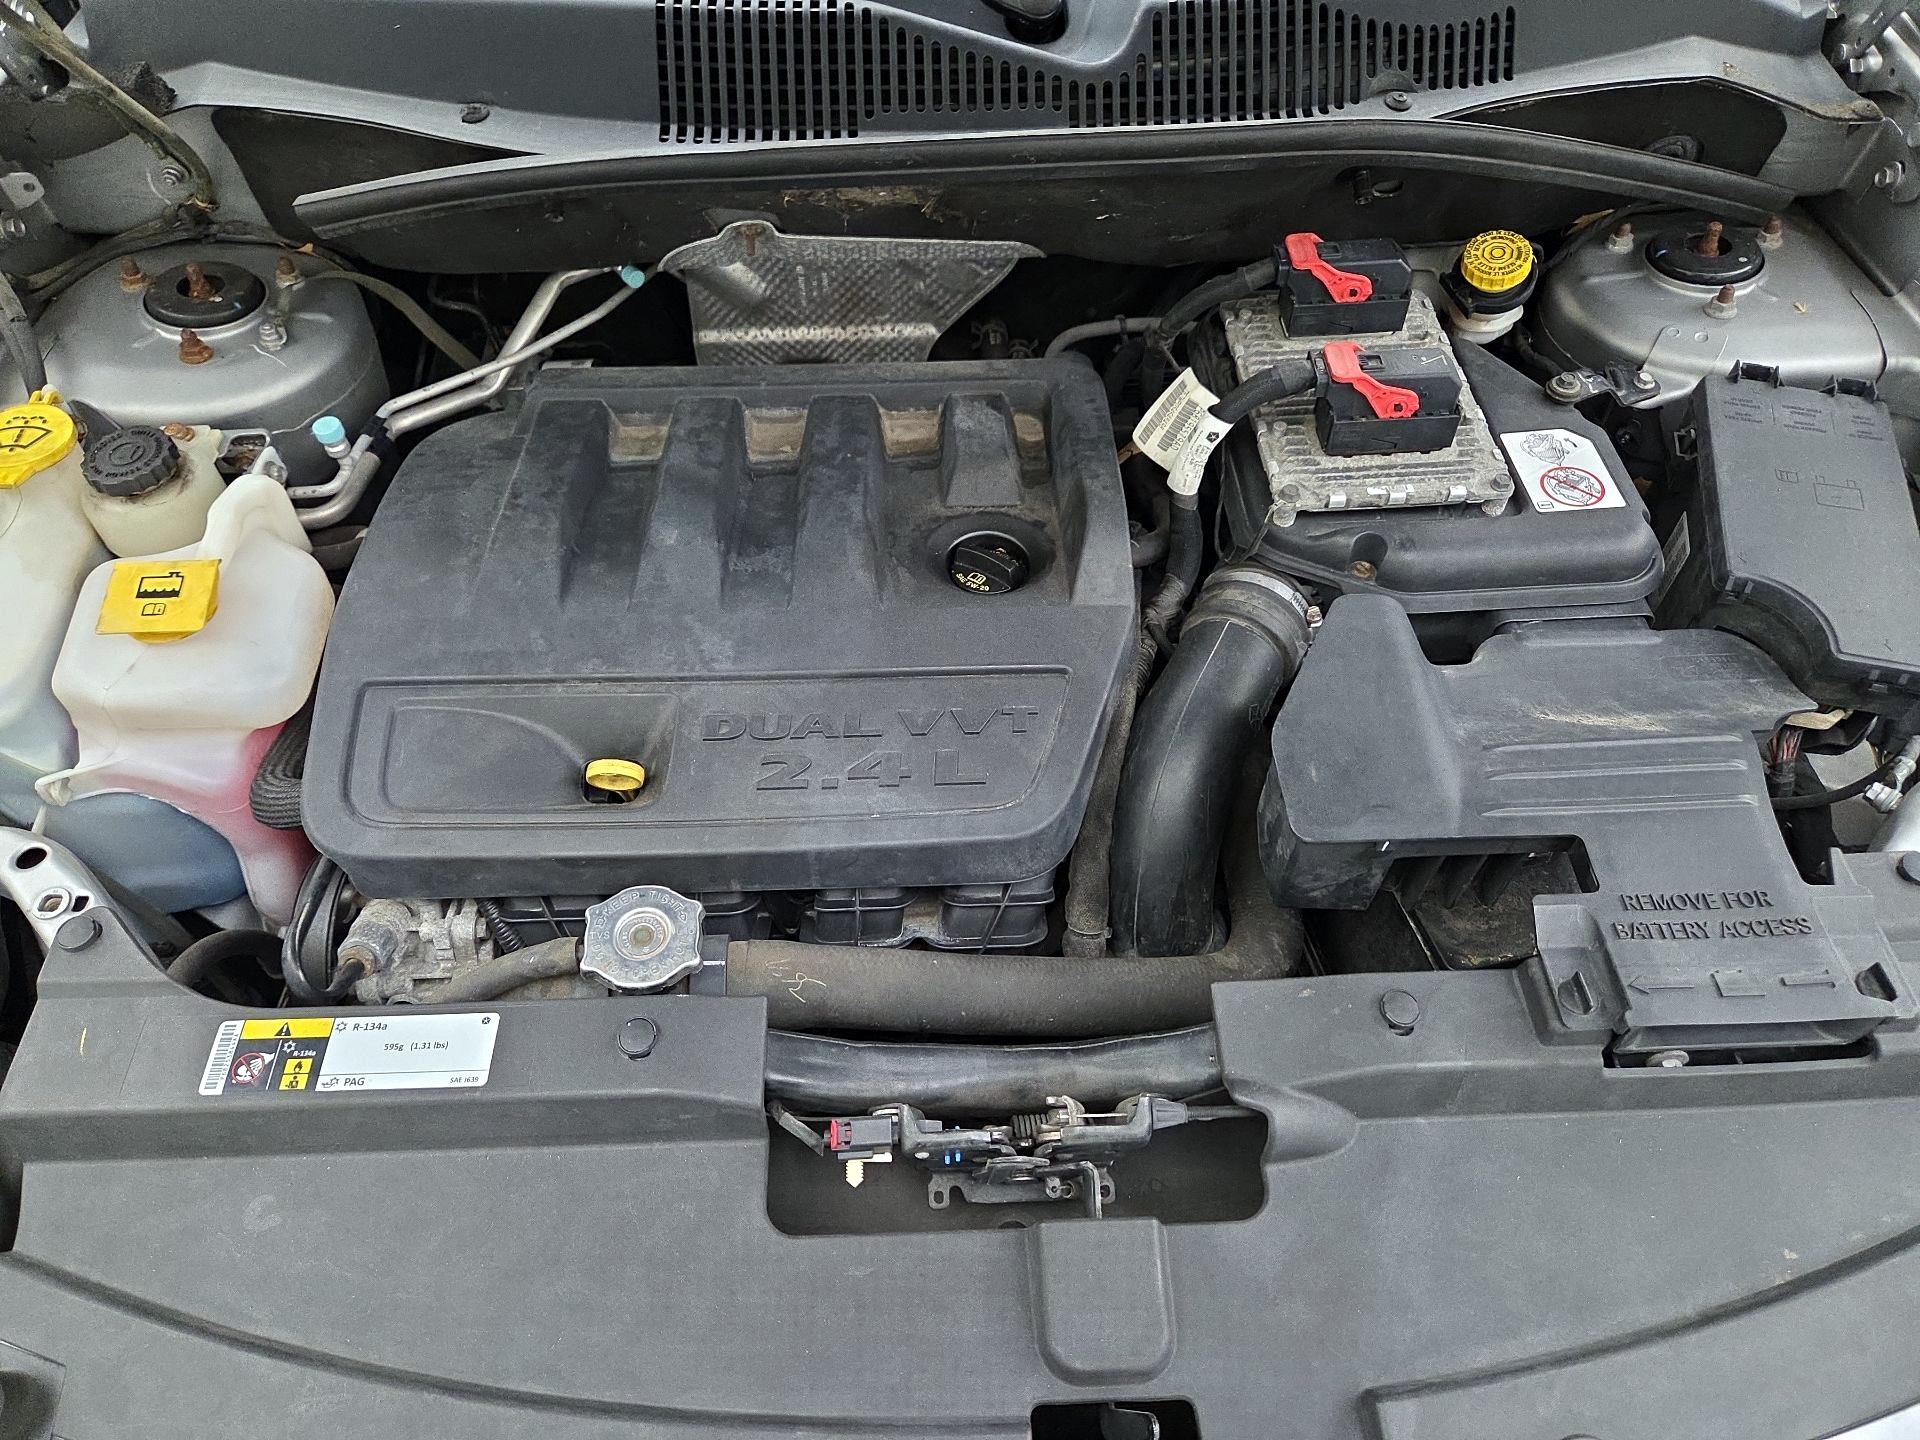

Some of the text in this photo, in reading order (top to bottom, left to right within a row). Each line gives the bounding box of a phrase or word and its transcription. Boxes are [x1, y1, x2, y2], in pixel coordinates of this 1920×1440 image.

[966, 581, 990, 592] 5W-20
[703, 706, 1039, 741] DUAL VVT
[603, 890, 686, 914] KEEP TIGHT
[1620, 889, 1774, 911] REMOVE FOR
[1612, 917, 1813, 940] BATTERY ACCESS
[590, 931, 610, 940] TVS
[353, 1022, 388, 1032] R-134a
[384, 1040, 449, 1052] 595g (1.31 lbs)
[343, 1076, 365, 1087] PAG
